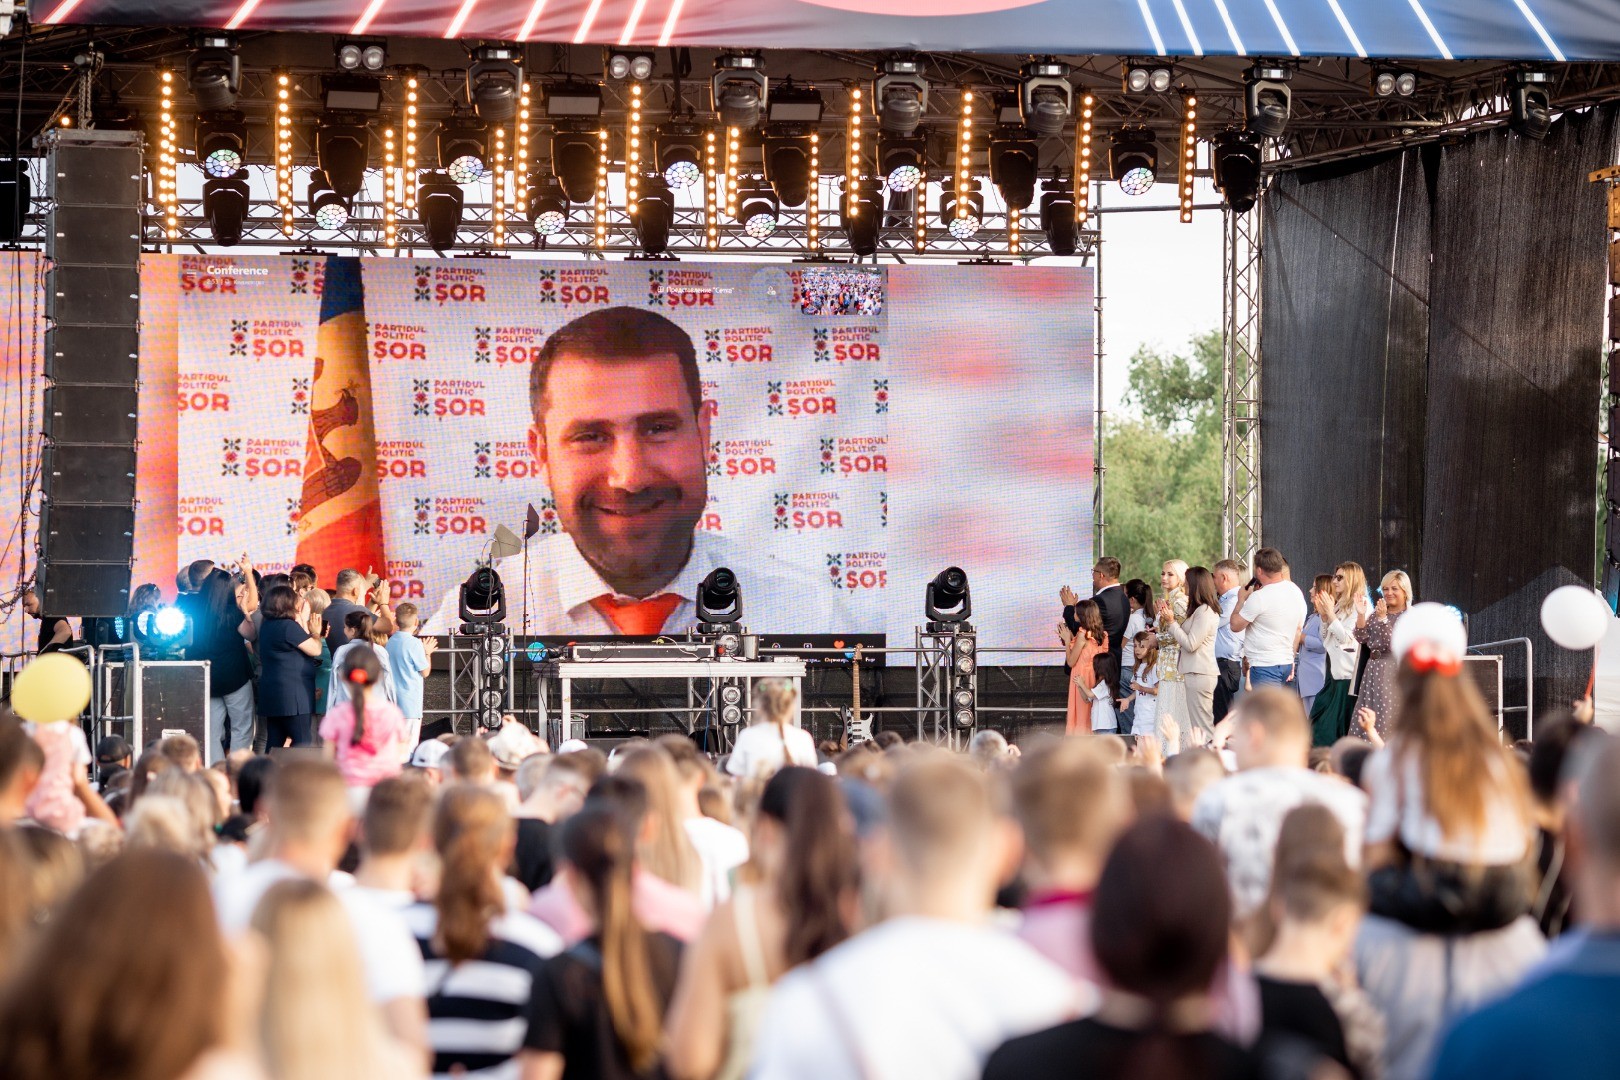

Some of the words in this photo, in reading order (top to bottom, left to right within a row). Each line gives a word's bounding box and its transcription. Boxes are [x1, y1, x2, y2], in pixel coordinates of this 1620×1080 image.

[207, 265, 268, 275] Conference
[435, 266, 486, 275] PARTIDUL
[668, 270, 713, 279] PARTIDUL
[668, 278, 704, 286] POLITIC
[254, 320, 303, 329] PARTIDUL
[375, 323, 426, 333] PARTIDUL
[496, 327, 544, 335] PARTIDUL
[724, 327, 773, 335] PARTIDUL
[832, 326, 880, 334] PARTIDUL
[375, 332, 415, 340] POLITIC
[495, 335, 534, 343] POLITIC
[434, 380, 485, 388] PARTIDUL
[786, 379, 836, 388] PARTIDUL
[434, 388, 474, 396] POLITIC
[786, 387, 825, 395] POLITIC
[246, 439, 301, 447] PARTIDUL
[376, 441, 424, 449] PARTIDUL
[838, 437, 887, 445] PARTIDUL
[246, 447, 290, 455] POLITIC
[376, 449, 415, 457] POLITIC
[839, 445, 877, 453] POLITIC
[179, 496, 224, 505] ARTIDUL
[435, 497, 486, 505] PARTIDUL
[179, 505, 213, 513] OLITIC
[435, 506, 475, 514] POLITIC
